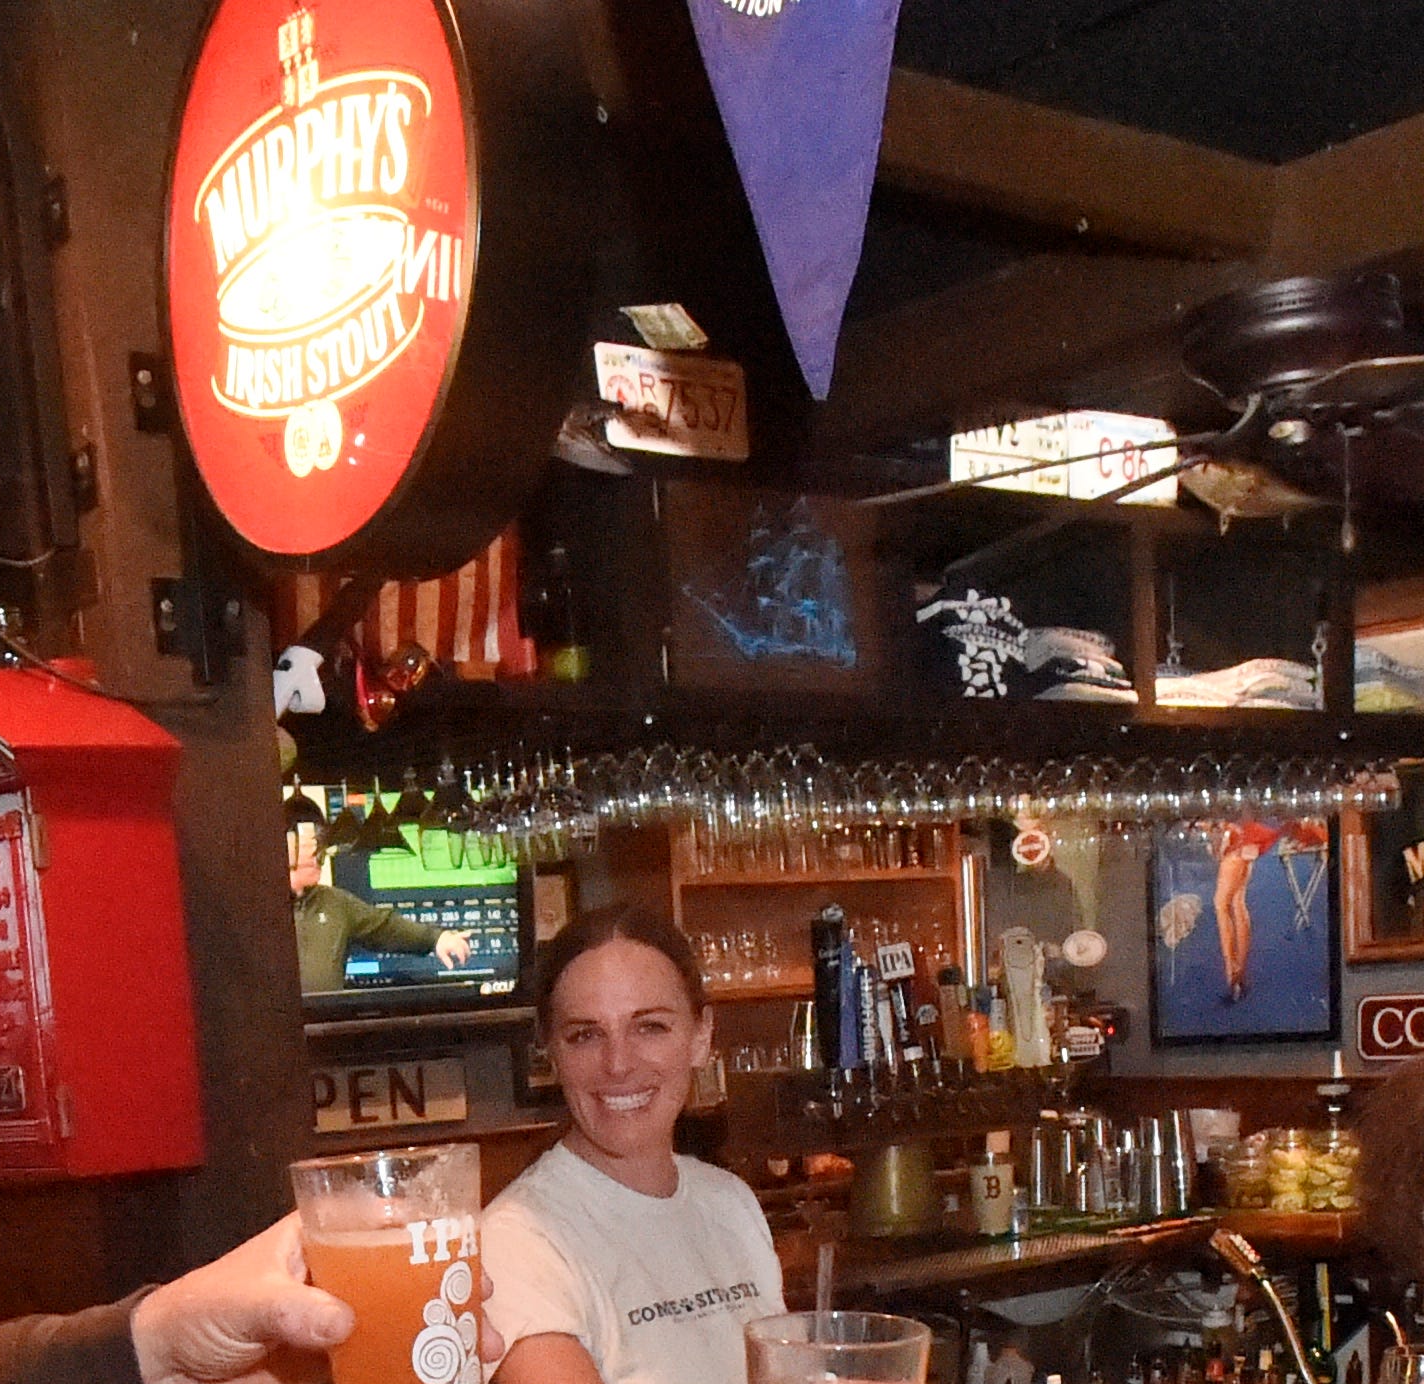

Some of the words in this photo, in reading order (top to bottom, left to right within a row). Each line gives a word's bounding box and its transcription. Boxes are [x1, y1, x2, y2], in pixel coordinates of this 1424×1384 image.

[204, 82, 412, 274] MURPHY'S
[225, 344, 304, 408] IRISH
[304, 293, 407, 397] STOUT
[881, 950, 912, 973] IPA
[309, 1066, 427, 1126] PEN
[407, 1219, 479, 1265] IPA
[628, 1300, 682, 1326] COME
